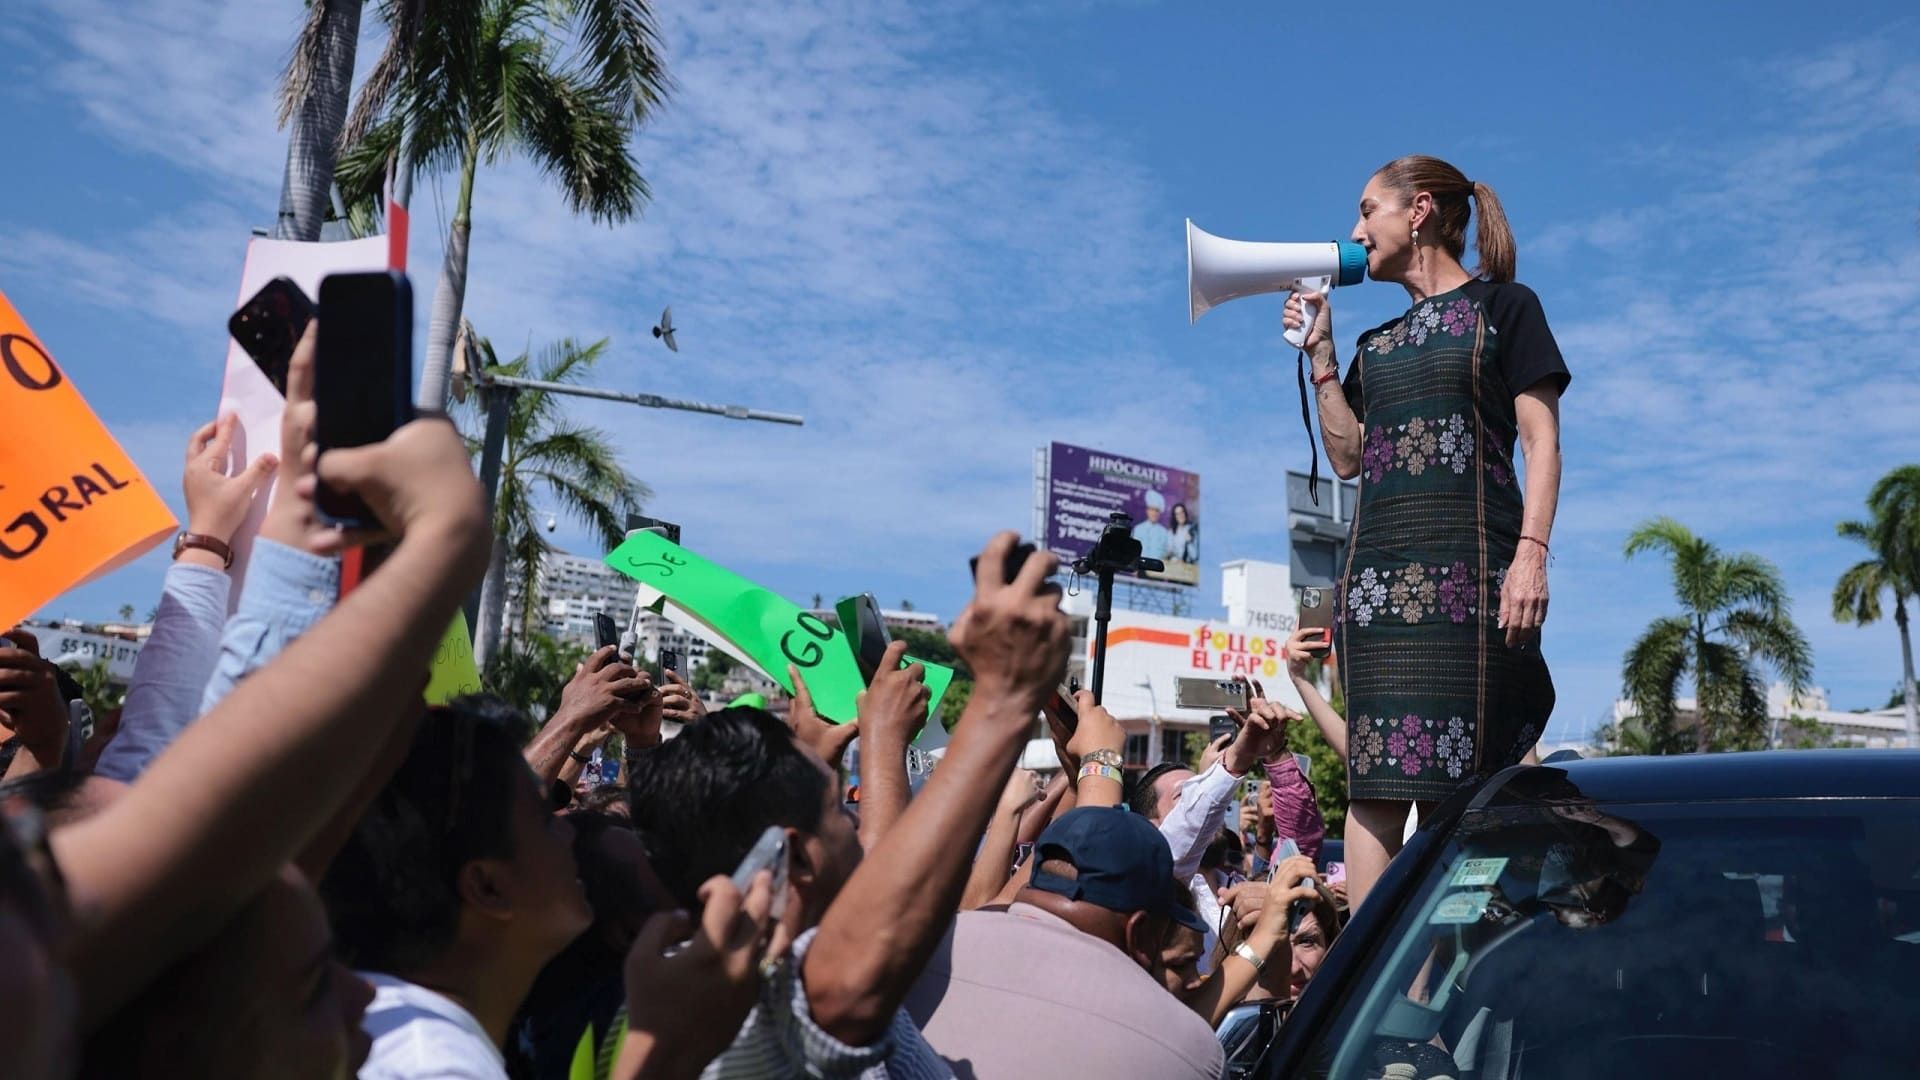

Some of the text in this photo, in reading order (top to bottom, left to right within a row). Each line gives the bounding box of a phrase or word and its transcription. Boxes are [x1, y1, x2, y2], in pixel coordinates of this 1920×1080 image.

[1089, 455, 1169, 481] HIPÓCRATES
[1247, 610, 1295, 632] 744592
[1198, 627, 1277, 657] POLLOS
[1192, 650, 1278, 678] EL PAPO
